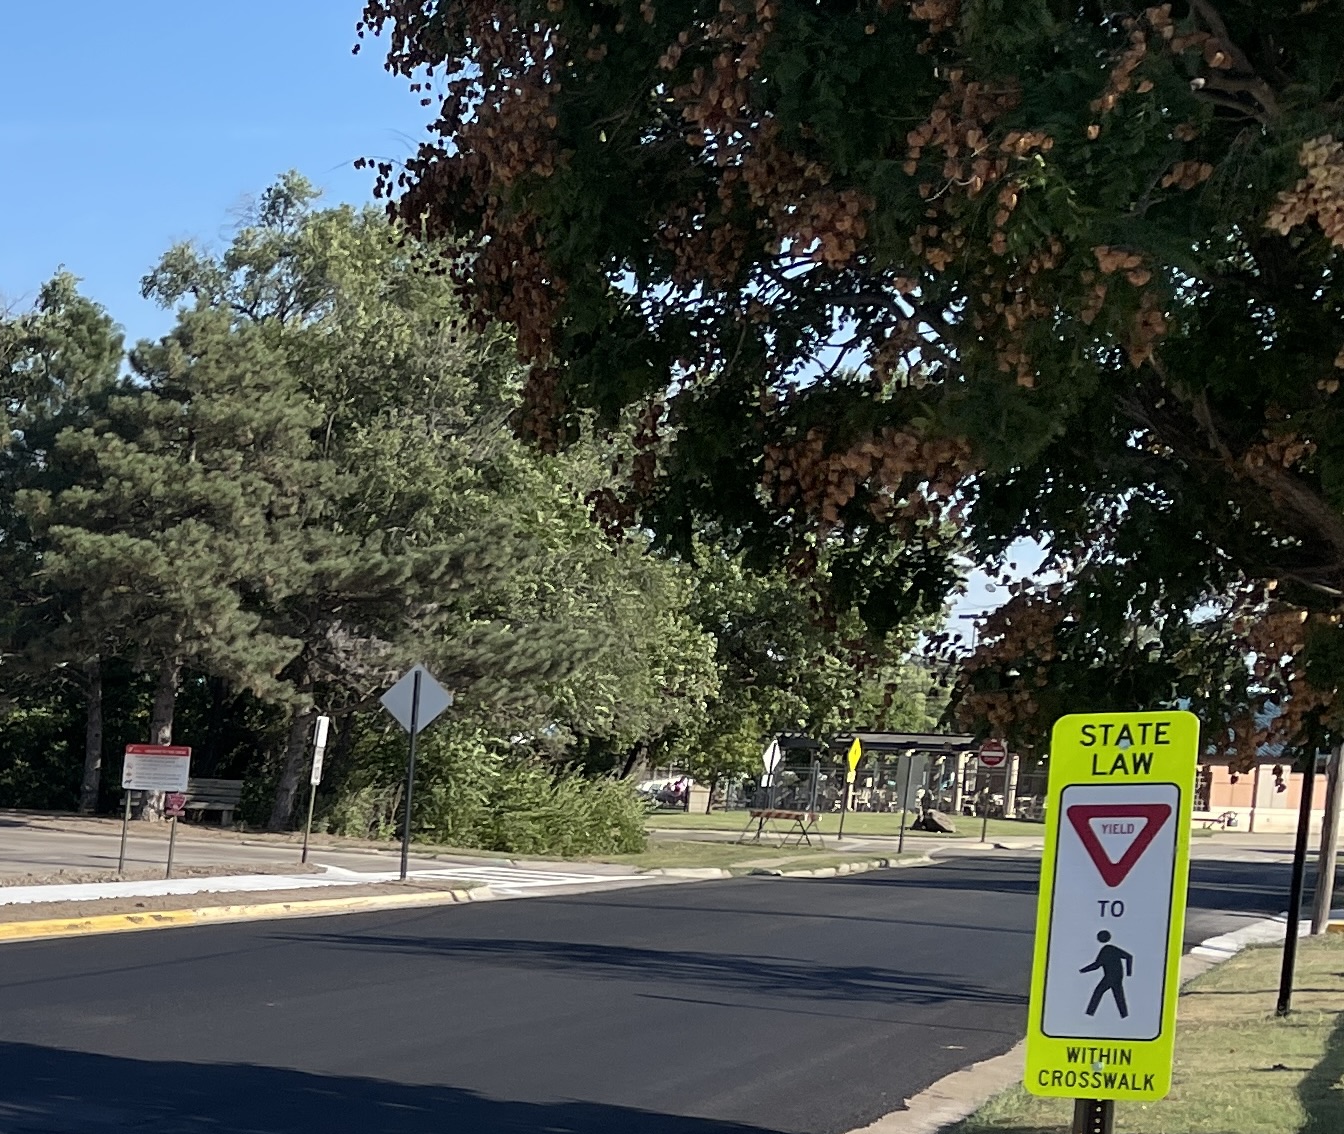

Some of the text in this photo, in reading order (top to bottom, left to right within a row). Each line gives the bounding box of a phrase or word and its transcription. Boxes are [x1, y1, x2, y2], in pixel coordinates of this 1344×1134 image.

[1079, 722, 1171, 747] STATE
[1092, 752, 1153, 775] LAW
[1102, 823, 1135, 835] YIELD
[1097, 900, 1124, 918] TO
[1066, 1047, 1132, 1066] WITHIN
[1038, 1069, 1155, 1091] CROSSWALK
